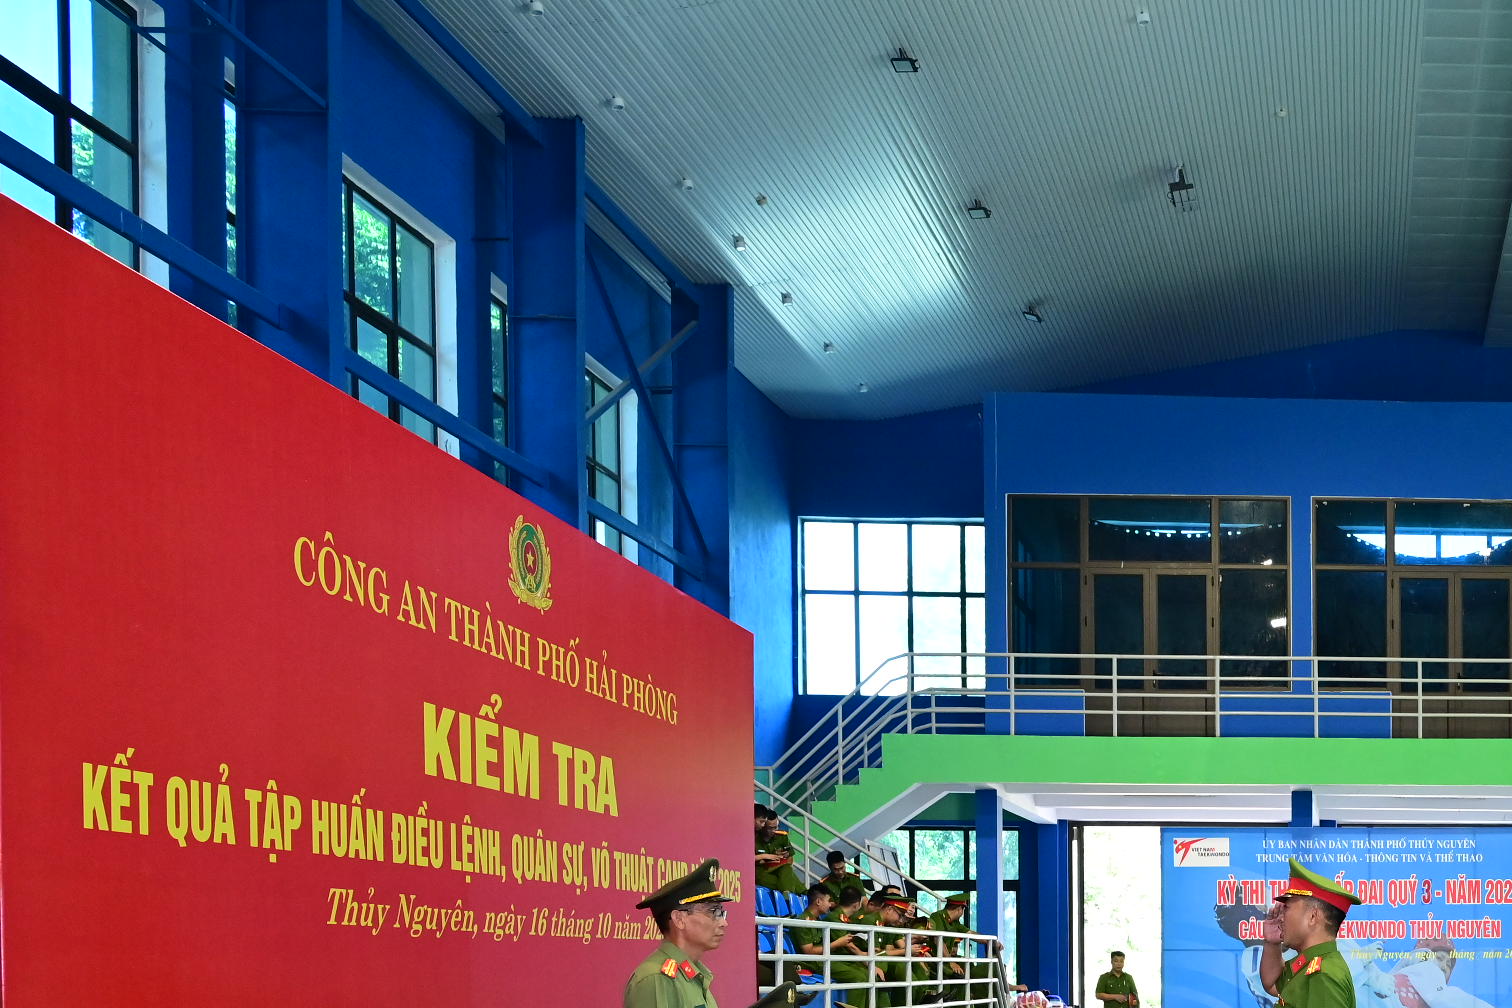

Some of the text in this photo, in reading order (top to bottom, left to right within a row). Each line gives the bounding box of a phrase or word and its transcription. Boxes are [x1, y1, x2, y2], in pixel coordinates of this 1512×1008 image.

[293, 531, 679, 726] CÔNG AN THÀNH PHỐ HẢI PHÒNG
[423, 693, 619, 818] KIỂM TRA
[82, 747, 154, 836] KẾT
[166, 763, 236, 848] QUẢ
[244, 780, 302, 864] TẬP
[311, 788, 385, 862] HUẤN
[391, 800, 444, 874] ĐIỀU
[450, 815, 506, 884] LỆNH,
[512, 829, 558, 885] QUÂN
[563, 841, 588, 896] SỰ,
[591, 841, 611, 889] VÕ
[614, 847, 655, 901] THUẬT
[1256, 853, 1290, 863] TRUNG
[1291, 850, 1314, 863] TÂM
[1314, 851, 1335, 863] VĂN
[1336, 851, 1358, 863] HÓA
[1365, 851, 1399, 863] THÔNG
[1400, 853, 1417, 863] TIN
[1419, 851, 1433, 863] VÀ
[1435, 849, 1455, 863] THỂ
[1457, 853, 1484, 863] THAO
[1263, 835, 1476, 849] ỦY BAN NHÂN DÂN THÀNH PHỐ THỦY NGUYÊN
[1217, 874, 1239, 906] KỲ
[1240, 880, 1266, 906] THI
[1357, 879, 1385, 905] ĐAI
[1388, 874, 1419, 908] QUÝ
[1421, 879, 1432, 905] 3
[1445, 874, 1483, 905] NĂM
[327, 887, 665, 945] Thủy Nguyên, ngày 16 tháng 10 năm 202
[1337, 919, 1406, 939] EKWONDO
[1410, 913, 1444, 939] THỦY
[1447, 916, 1503, 939] NGUYÊN
[1415, 949, 1437, 962] ngày
[1449, 948, 1475, 961] tháng
[1482, 949, 1503, 959] năm
